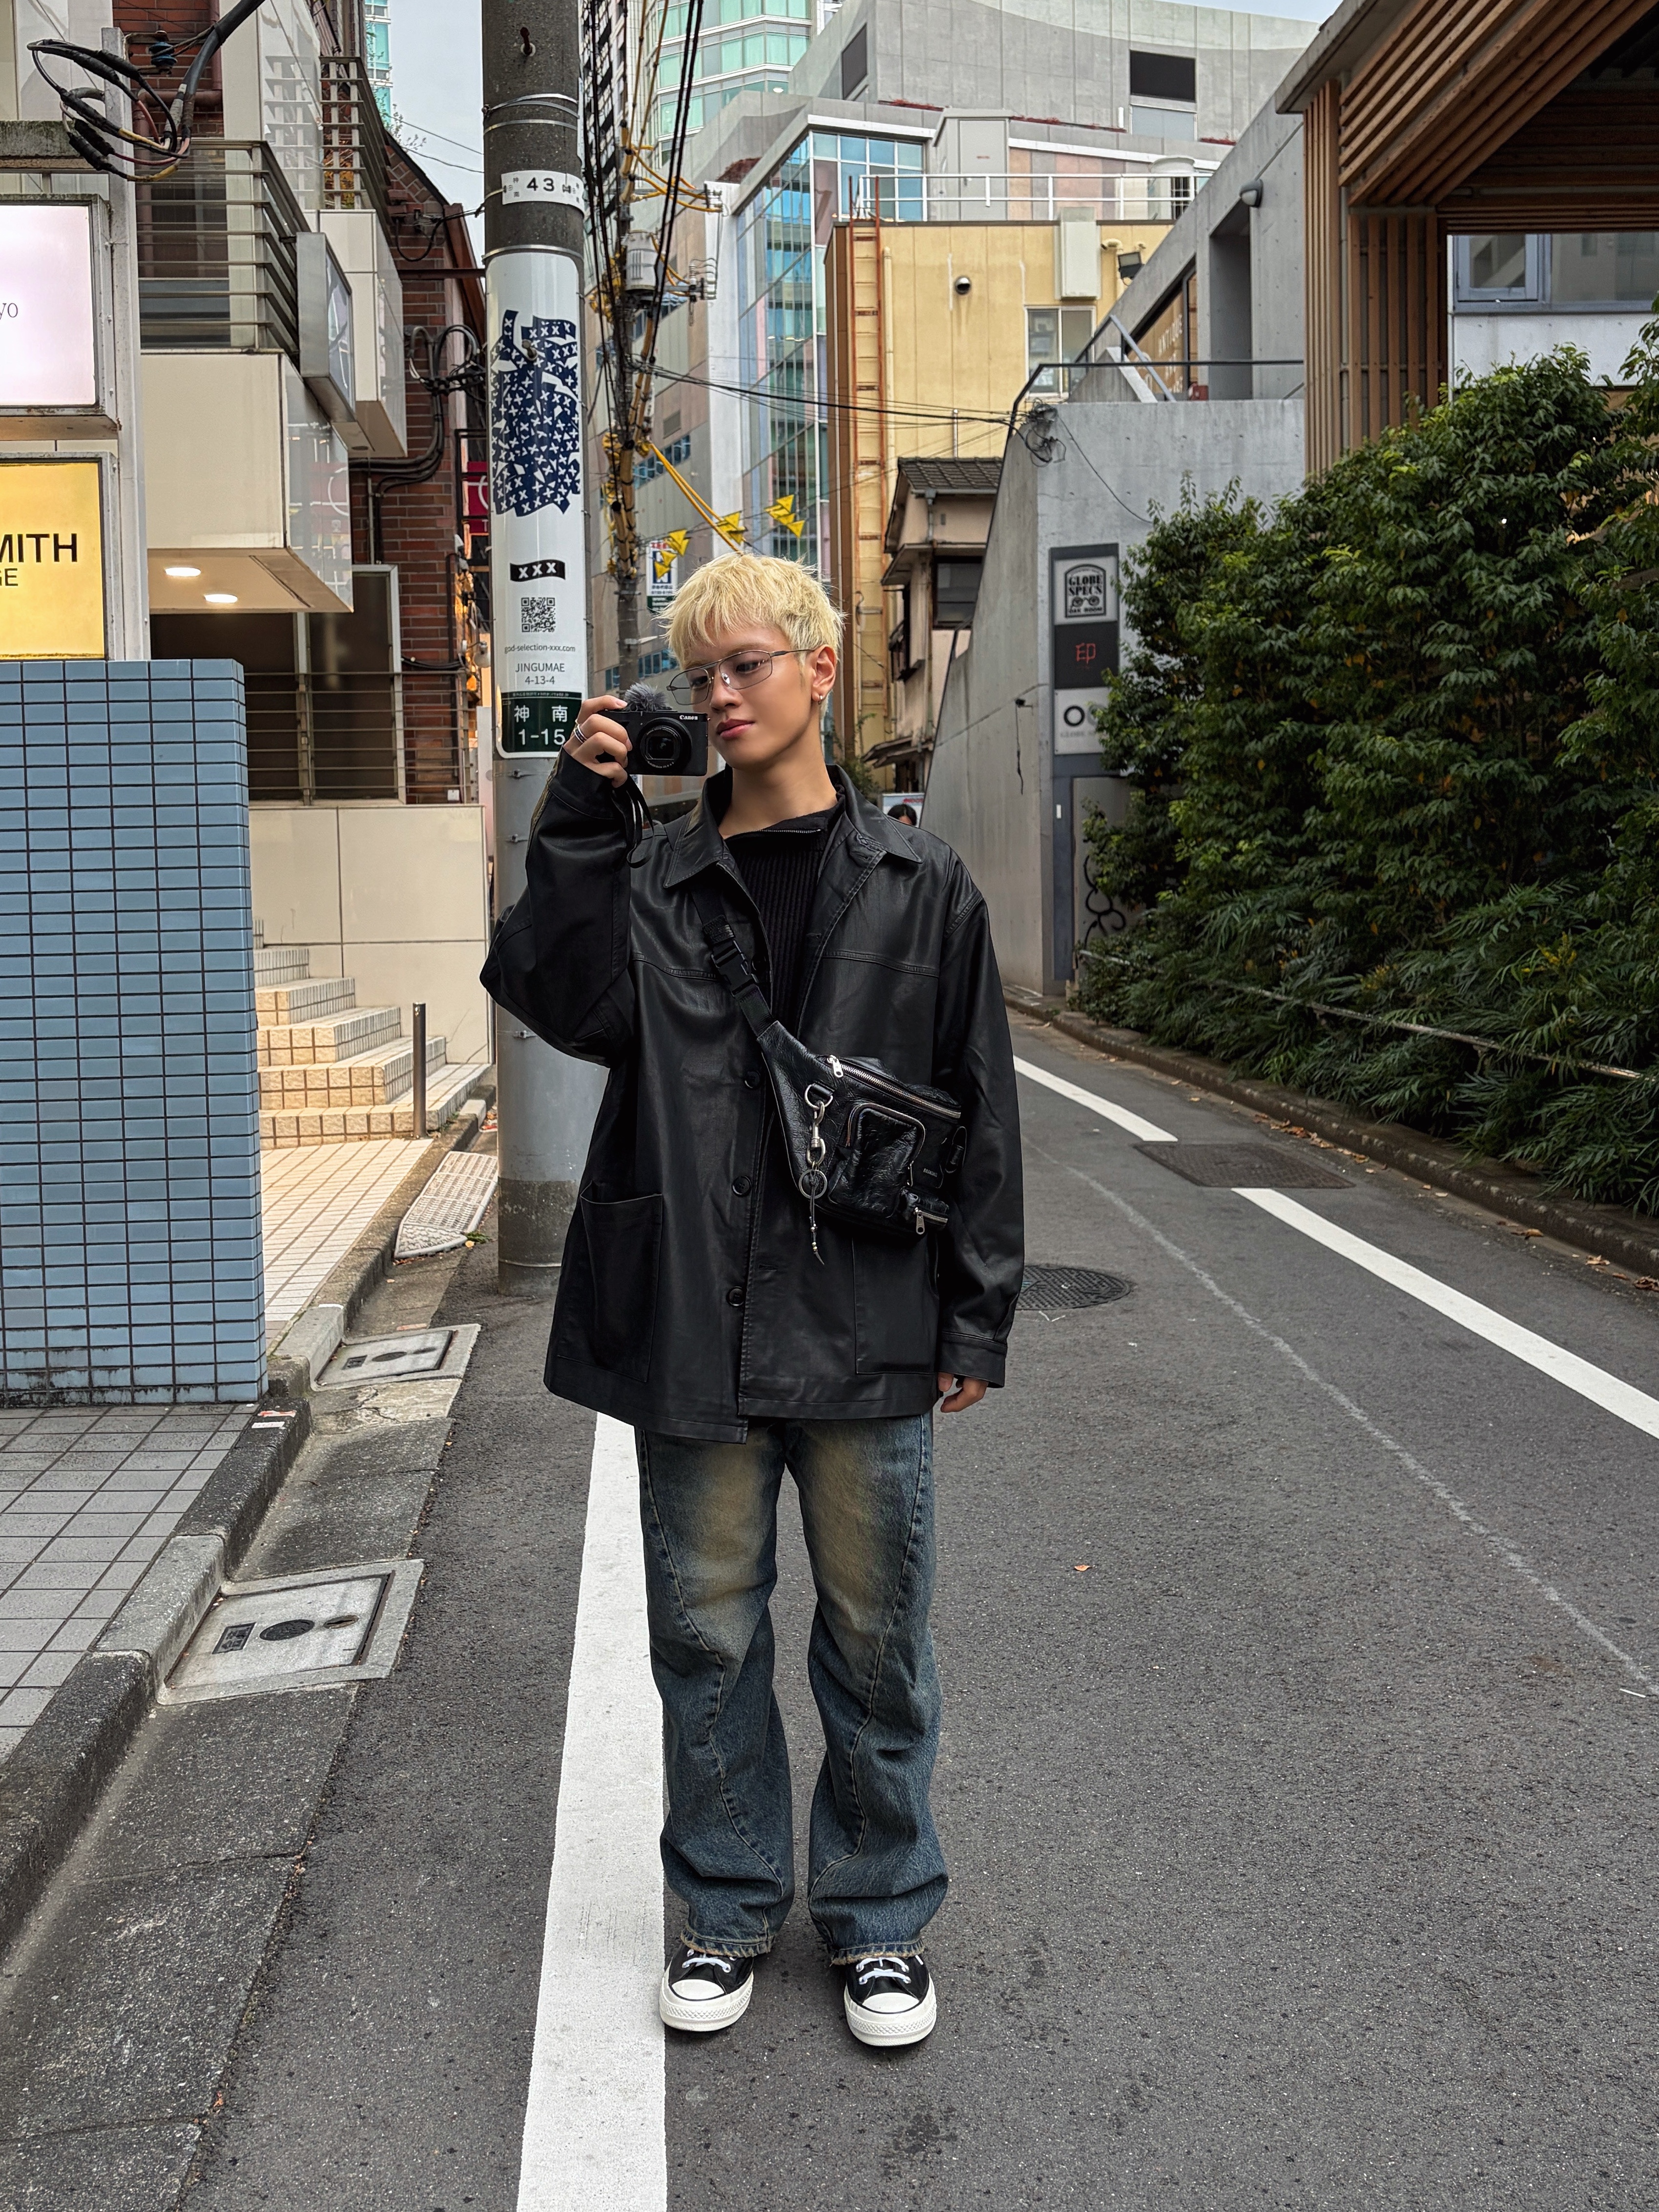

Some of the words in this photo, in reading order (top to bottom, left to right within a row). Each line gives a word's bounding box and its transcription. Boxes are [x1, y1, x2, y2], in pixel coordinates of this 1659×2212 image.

[526, 177, 555, 192] 43
[518, 562, 557, 579] XXX
[0, 568, 19, 586] E
[1068, 575, 1102, 586] GLOBE
[1068, 586, 1102, 596] SPECS
[504, 643, 576, 654] god-selection-xxx.com
[515, 662, 566, 673] JINGUMAE
[524, 675, 556, 685] 4-13-4
[518, 728, 566, 745] 1-15
